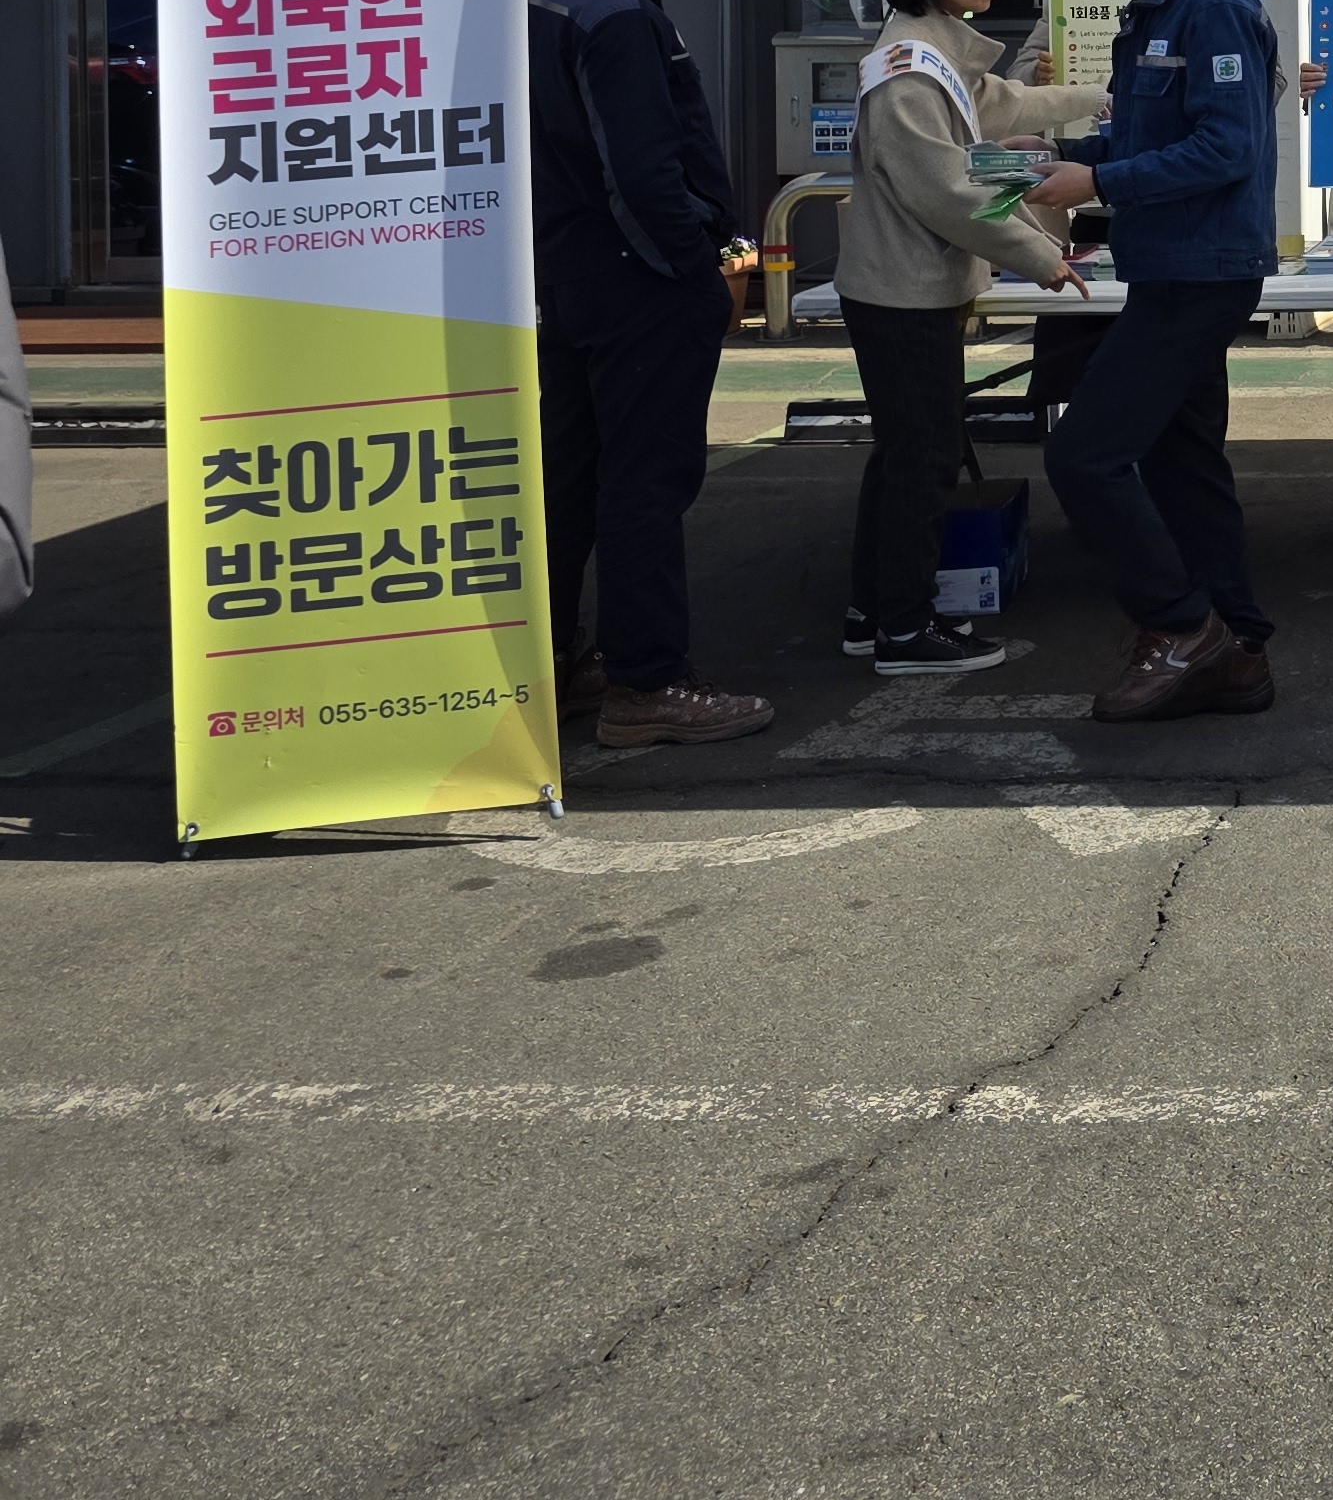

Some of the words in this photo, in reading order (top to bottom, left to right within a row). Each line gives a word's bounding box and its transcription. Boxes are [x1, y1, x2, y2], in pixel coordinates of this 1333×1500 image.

[1069, 5, 1111, 20] 1회용품
[208, 37, 429, 114] 근로자
[206, 103, 506, 186] 지원센터
[209, 207, 288, 233] GEOJE
[292, 197, 403, 227] SUPPORT
[409, 190, 501, 216] CENTER
[209, 234, 259, 259] FOR
[264, 227, 366, 256] FOREIGN
[369, 217, 486, 247] WORKERS
[201, 426, 520, 526] 찾아가는
[205, 516, 524, 621] 방문상담
[241, 705, 306, 734] 문의처
[319, 684, 530, 727] 055-635-1254~5
